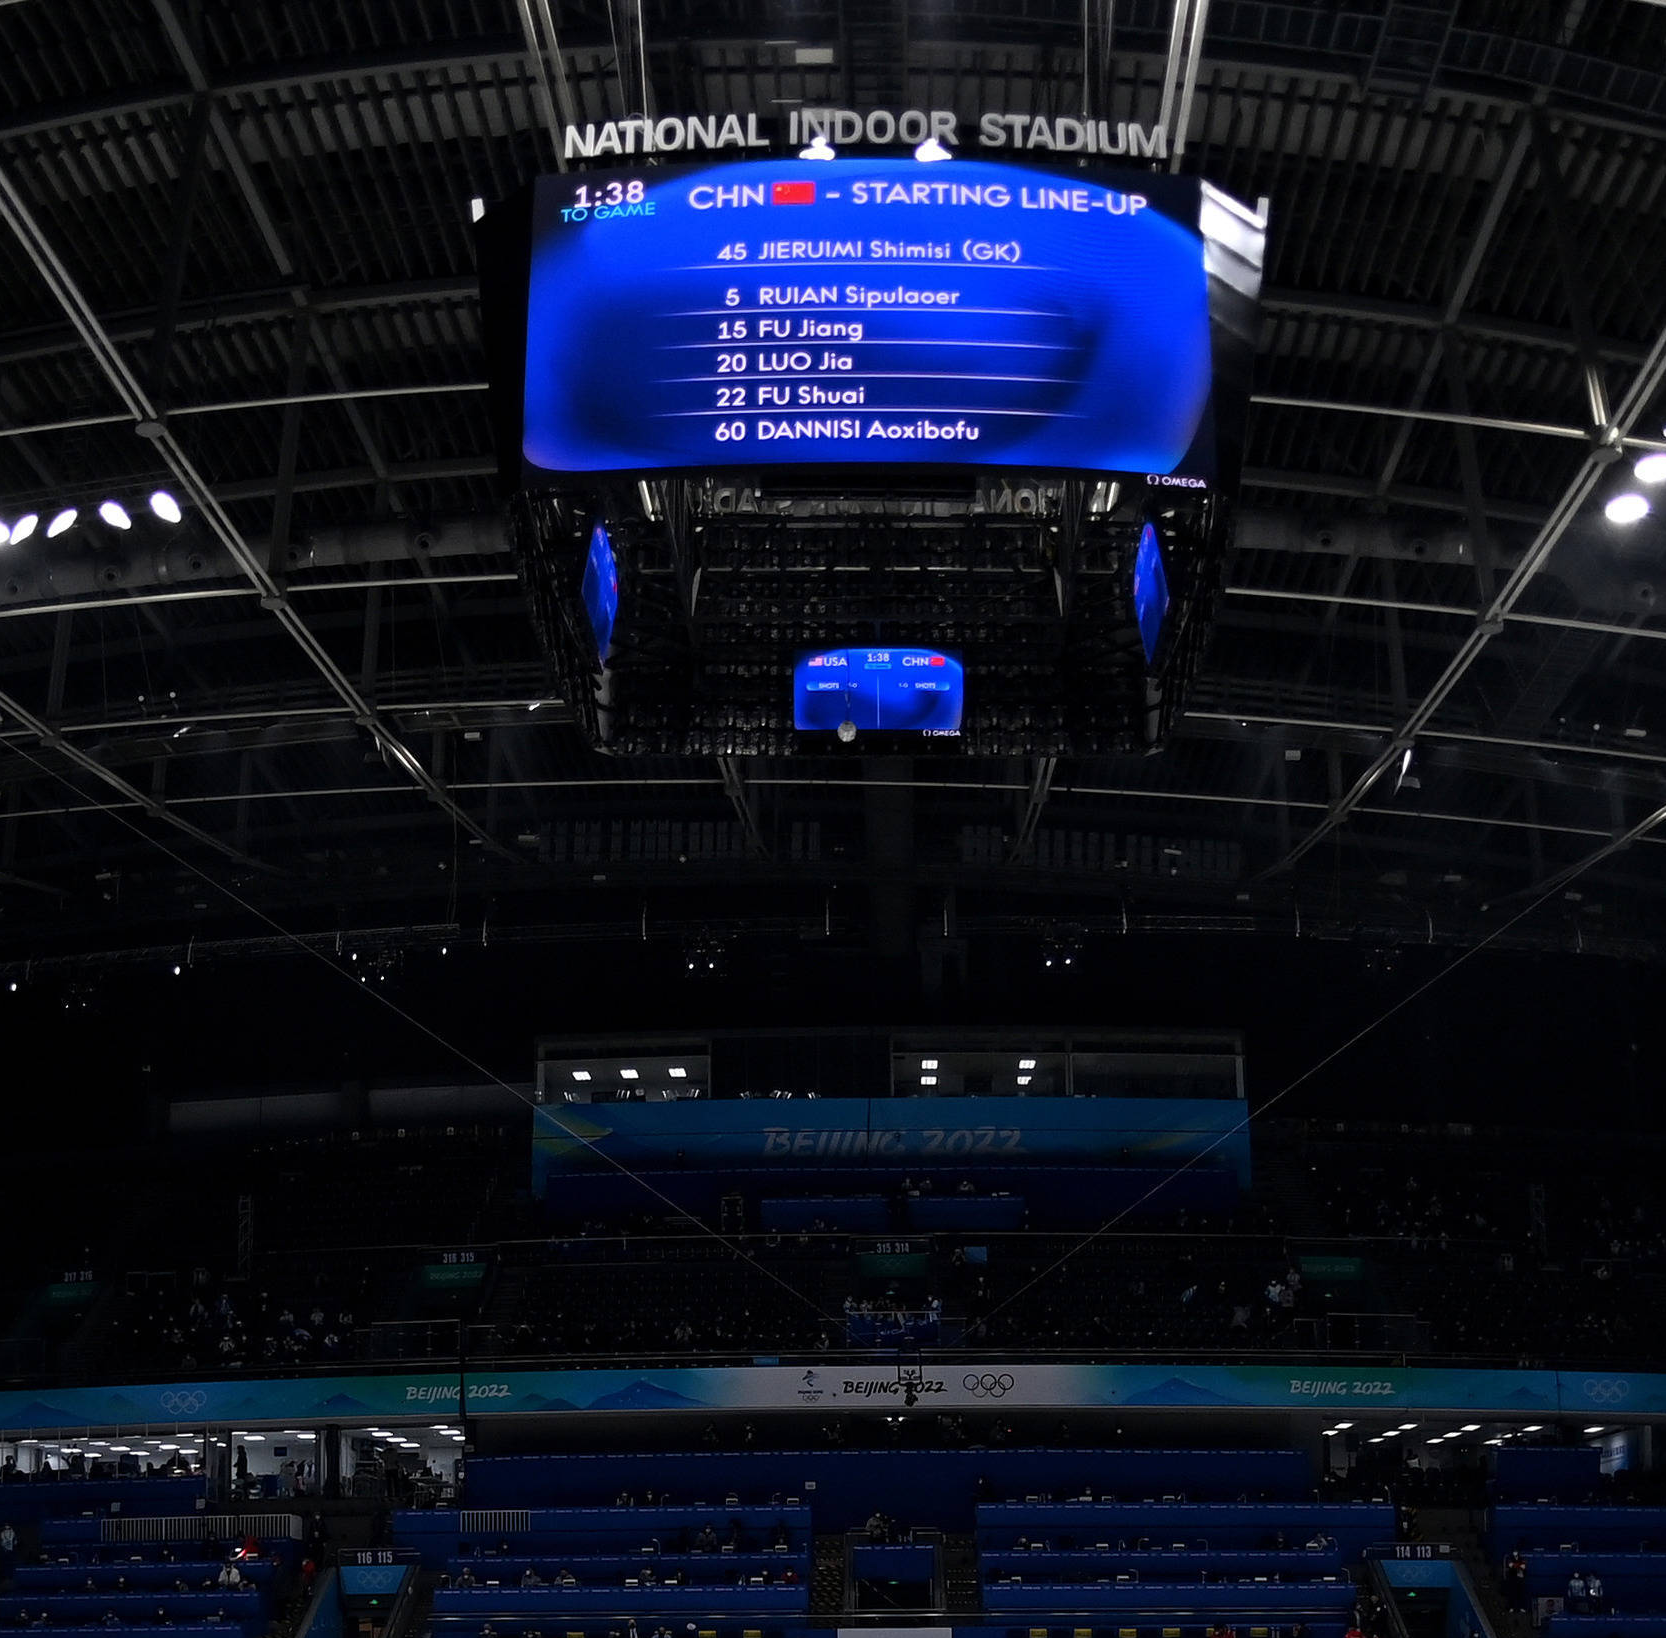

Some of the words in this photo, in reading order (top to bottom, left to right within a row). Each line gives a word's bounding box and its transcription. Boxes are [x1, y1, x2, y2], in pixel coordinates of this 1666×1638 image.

[564, 112, 769, 157] NATIONAL
[788, 110, 958, 146] INDOOR
[979, 113, 1167, 158] STADIUM
[573, 180, 645, 208] 1:38
[688, 184, 764, 210] CHN
[852, 182, 1011, 207] STARTING
[1021, 186, 1148, 216] LINE-UP
[561, 206, 589, 222] TO
[593, 201, 656, 220] GAME
[717, 243, 747, 261] 45
[758, 241, 863, 260] JIERUIMI
[870, 239, 951, 259] Shimisi
[963, 238, 1021, 263] (GK)
[725, 287, 740, 306] 5
[759, 286, 837, 305] RUIAN
[844, 285, 959, 308] Sipulaoer
[718, 320, 747, 339] 15
[759, 319, 791, 338] FU
[797, 318, 864, 341] Jiang
[717, 353, 747, 372] 20
[758, 351, 812, 371] LUO
[818, 351, 854, 371] Jia
[716, 387, 746, 406] 22
[758, 386, 790, 405] FU
[798, 385, 865, 405] Shuai
[715, 421, 747, 441] 60
[757, 419, 860, 440] DANNISI
[866, 419, 979, 442] Aoxibofu
[1161, 476, 1207, 488] OMEGA
[823, 657, 848, 667] USA
[866, 653, 890, 662] 1:38
[902, 656, 929, 667] CHN
[762, 1126, 905, 1158] BEIJING
[919, 1126, 1027, 1157] 2022
[405, 1385, 462, 1404] BEIJING
[467, 1383, 514, 1399] 2022
[842, 1381, 899, 1398] BEIJING
[900, 1381, 948, 1395] 022
[1289, 1379, 1347, 1398] BEIJING
[1352, 1380, 1396, 1396] 2022
[357, 1551, 373, 1564] 116
[377, 1551, 393, 1564] 115
[1395, 1545, 1411, 1559] 114
[1416, 1545, 1432, 1559] 113
